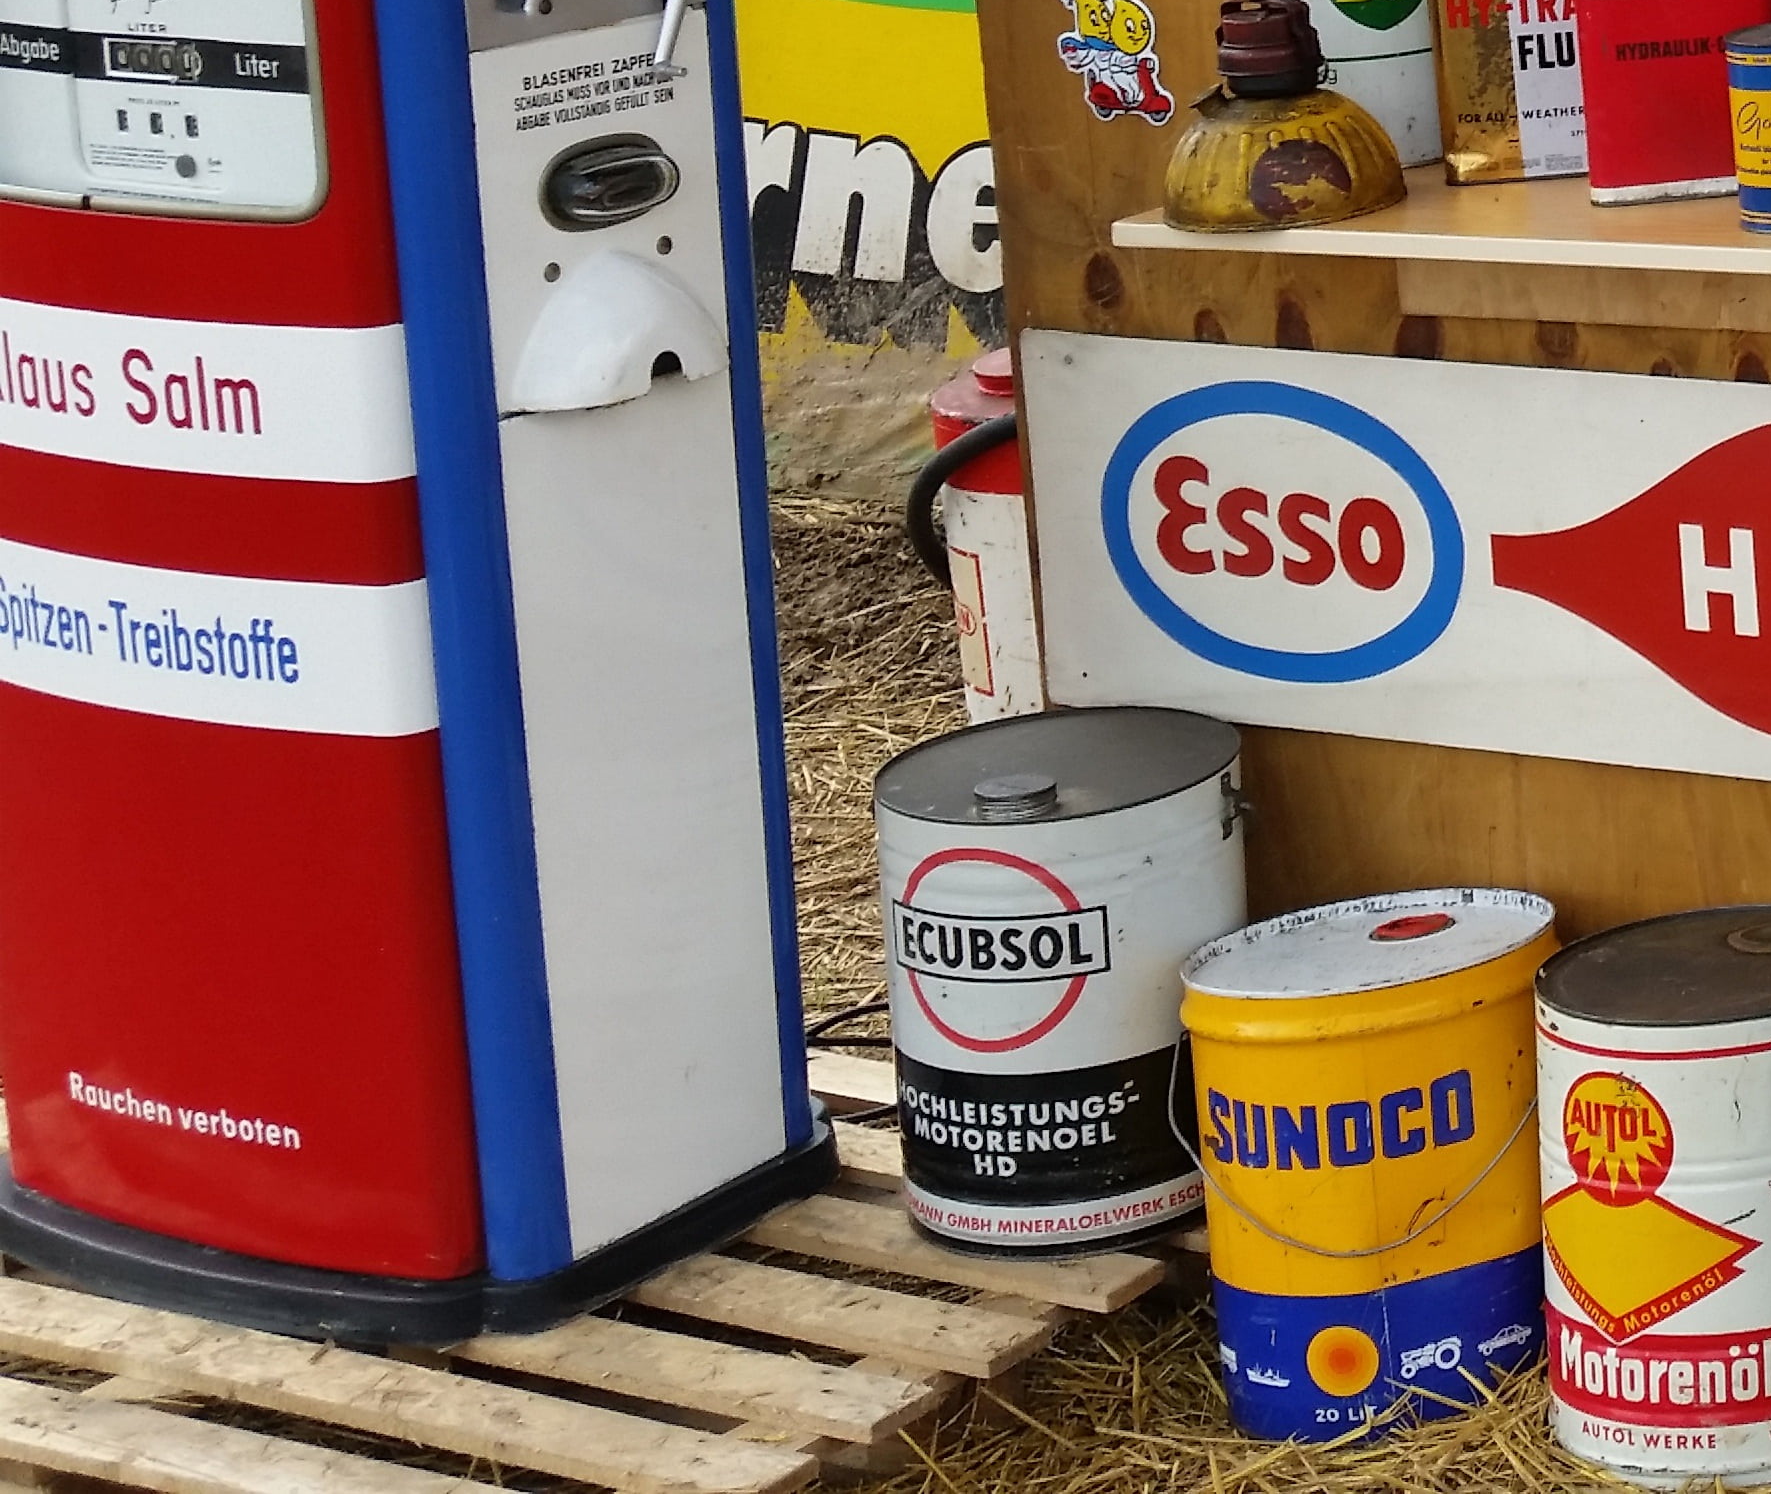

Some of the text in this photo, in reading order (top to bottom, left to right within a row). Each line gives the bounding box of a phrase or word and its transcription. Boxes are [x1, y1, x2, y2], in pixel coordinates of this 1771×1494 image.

[127, 23, 167, 33] LITER
[0, 33, 281, 79] Abgabe Liter
[522, 52, 656, 91] BLASENFREI ZAPFE
[1516, 32, 1576, 71] FLU
[514, 89, 564, 112] SCHAUGLAS
[566, 84, 592, 103] MUSS
[515, 112, 551, 131] ABGABE
[654, 87, 674, 104] SEIN
[1458, 113, 1481, 123] FOR
[0, 329, 262, 435] laus Salm
[901, 912, 1096, 974] ECUBSOL
[69, 1070, 302, 1150] Rauchen verboten
[1205, 1068, 1477, 1173] SUNOCO
[914, 1113, 1117, 1153] MOTORENOEL
[974, 1153, 1018, 1178] HD
[947, 1181, 1206, 1234] GMBH MINERALOELWERK ESCH
[1622, 1267, 1725, 1334] Motorenöl
[1315, 1408, 1340, 1423] 20
[1643, 1433, 1717, 1449] WERKE
